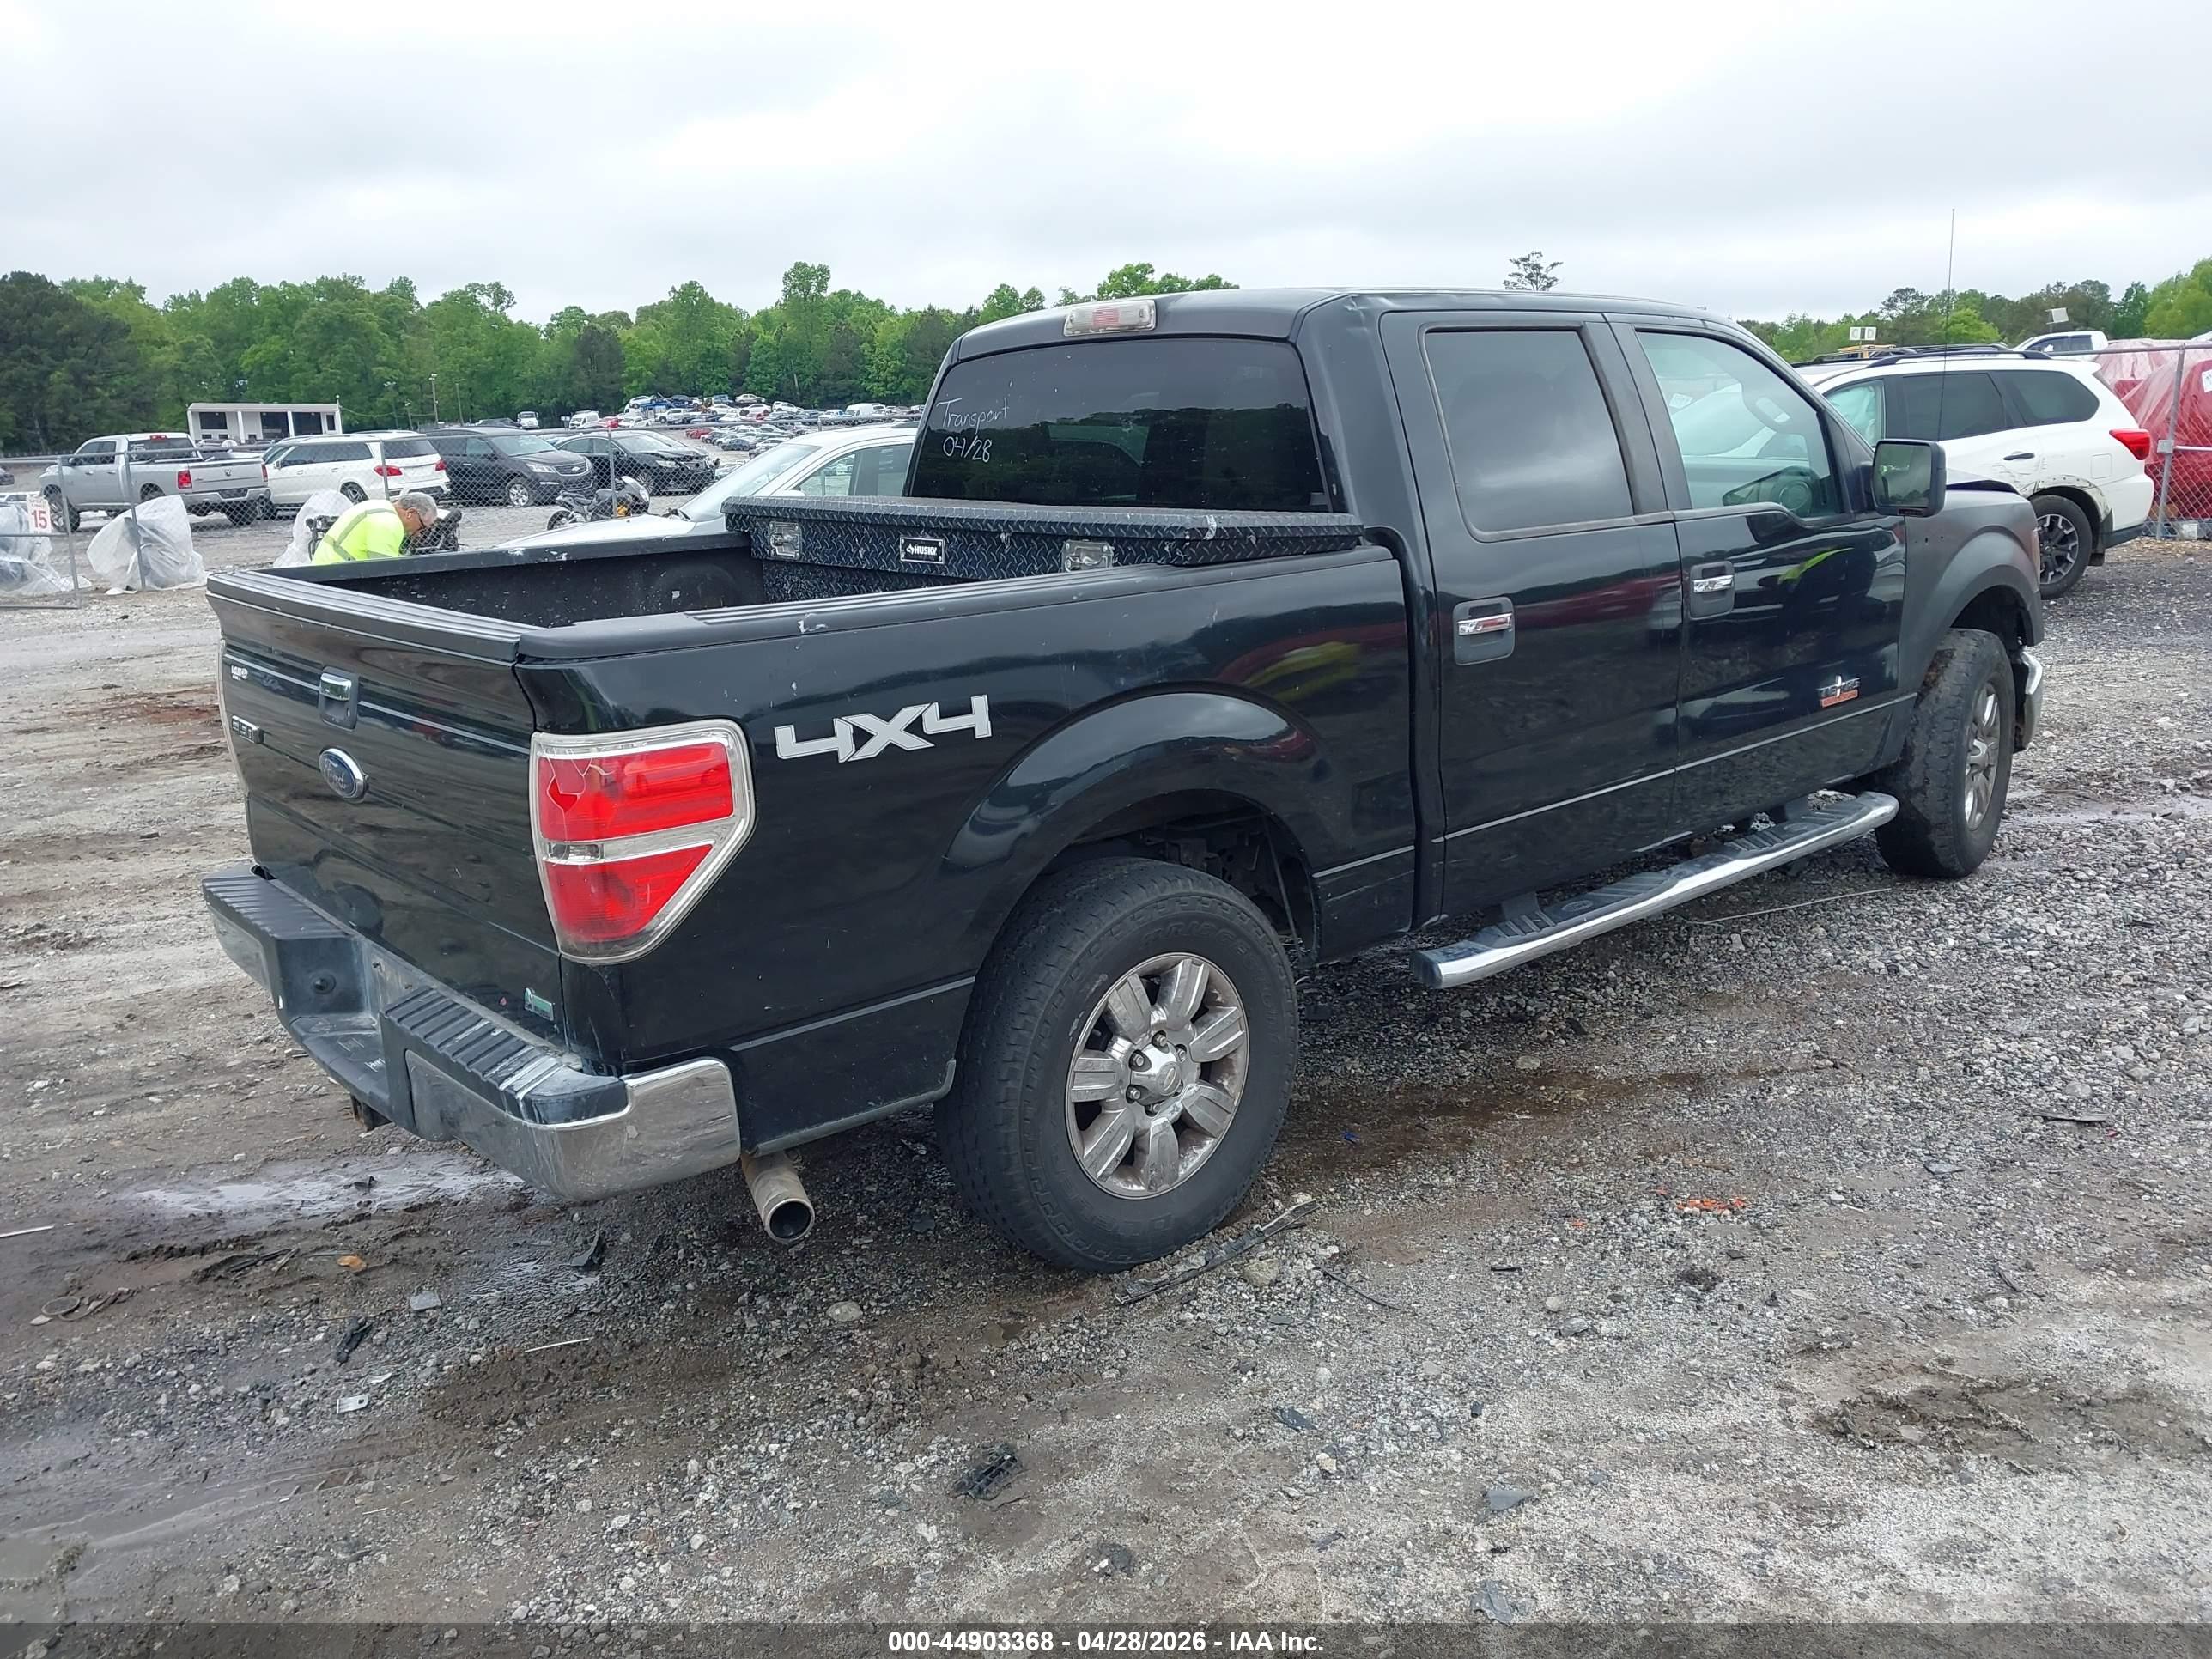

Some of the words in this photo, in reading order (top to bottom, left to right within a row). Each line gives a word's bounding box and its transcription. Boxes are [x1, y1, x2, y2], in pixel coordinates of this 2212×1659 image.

[936, 398, 1010, 434] Transport
[943, 435, 993, 463] 04/28
[31, 509, 48, 529] 15
[914, 544, 938, 556] HUSKY
[324, 757, 347, 790] Ford
